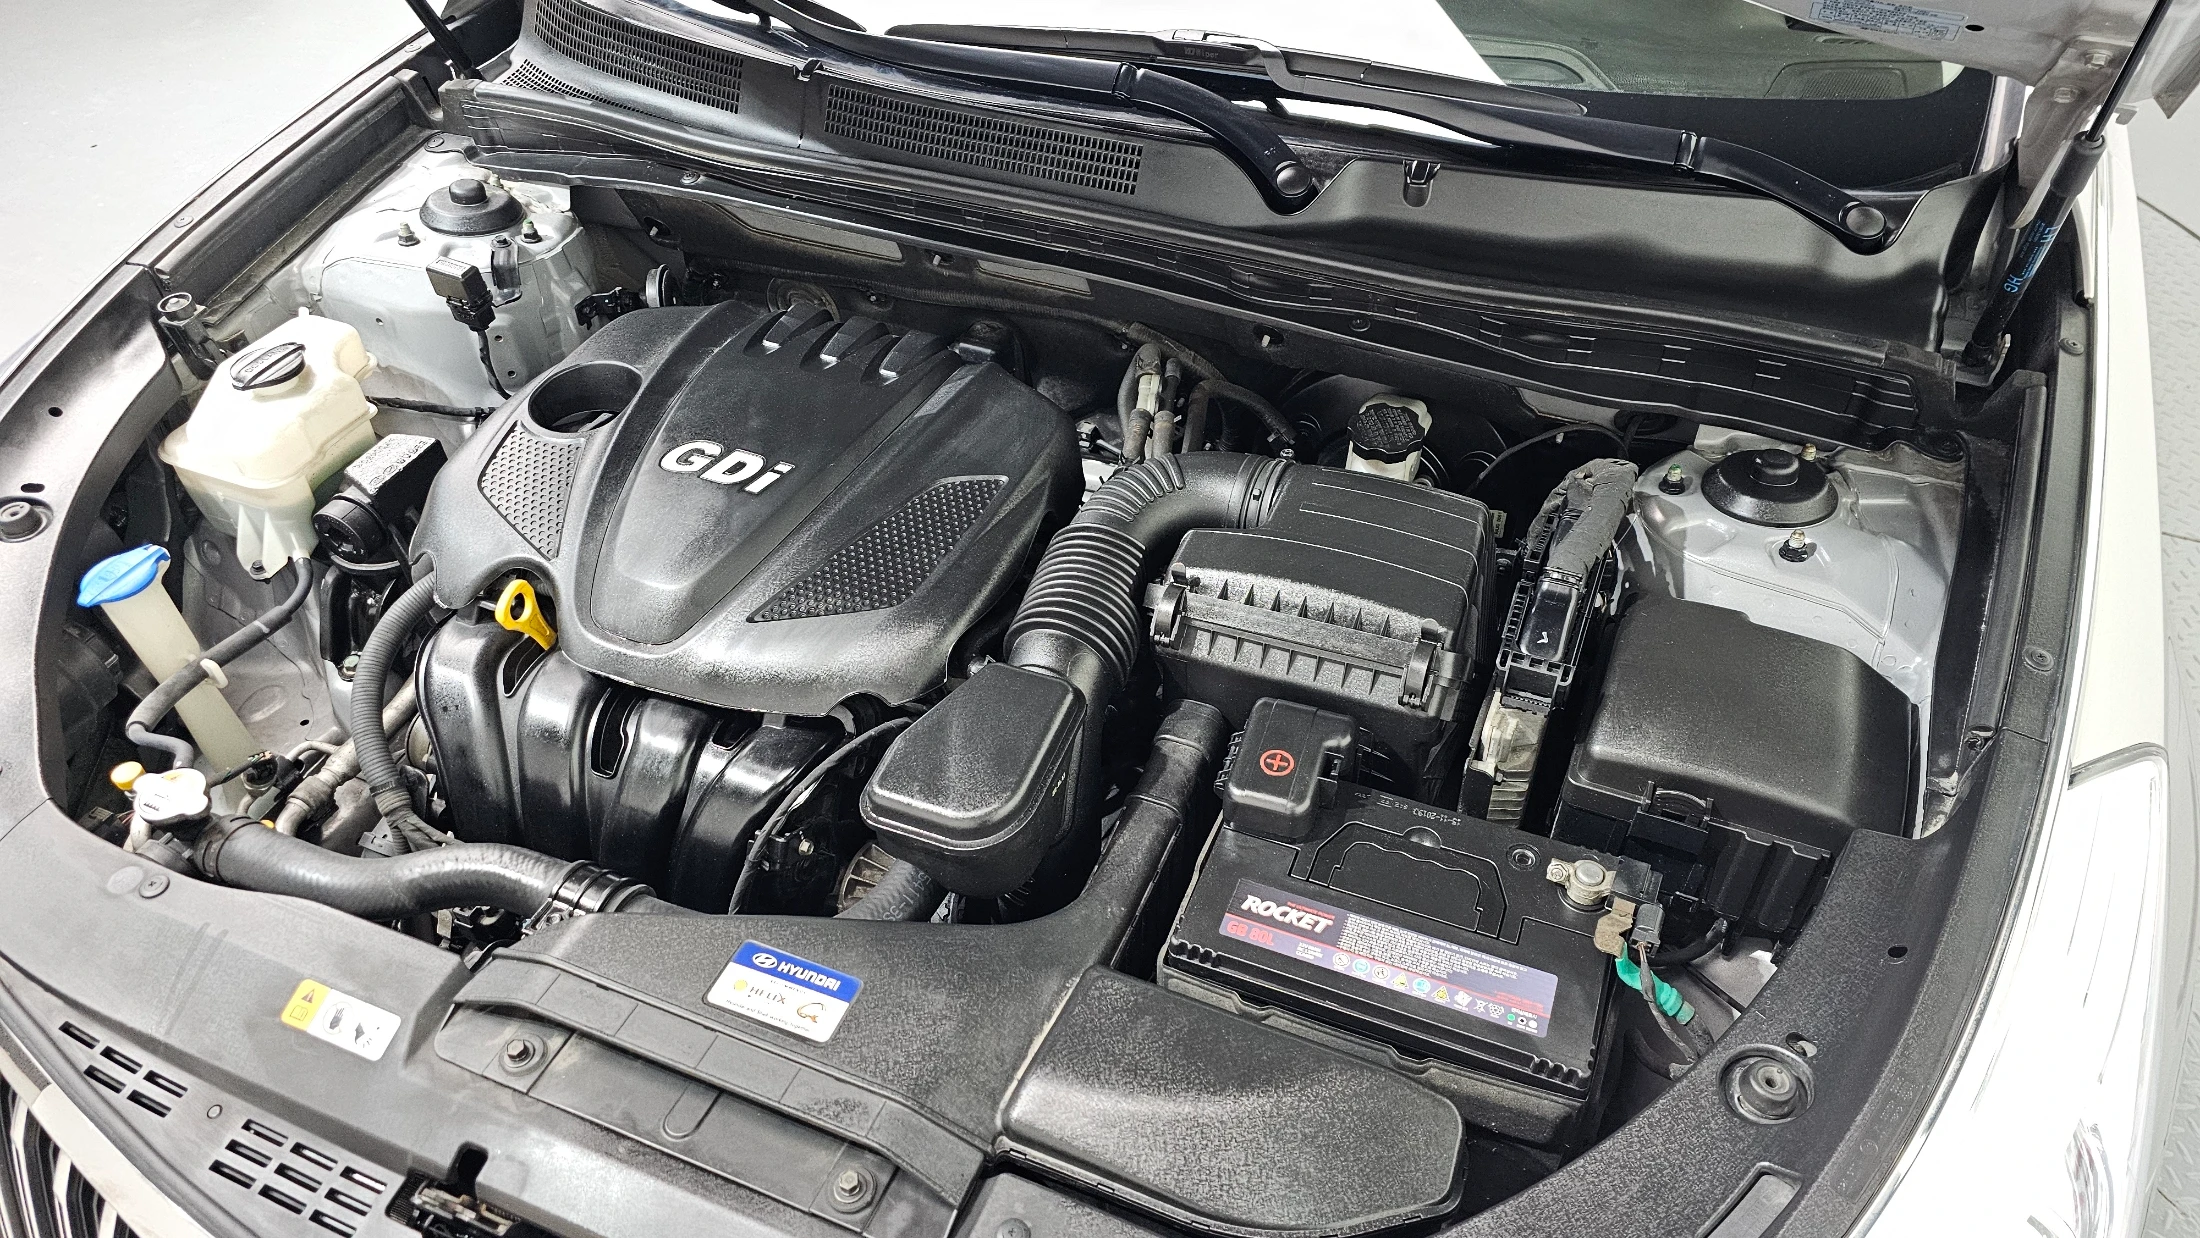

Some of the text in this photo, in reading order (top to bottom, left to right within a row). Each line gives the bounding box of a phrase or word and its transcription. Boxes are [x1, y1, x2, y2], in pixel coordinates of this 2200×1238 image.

[658, 439, 796, 494] GDi
[1226, 920, 1249, 937] GB
[1240, 894, 1334, 934] ROCKET
[777, 961, 841, 991] HYUNDAI
